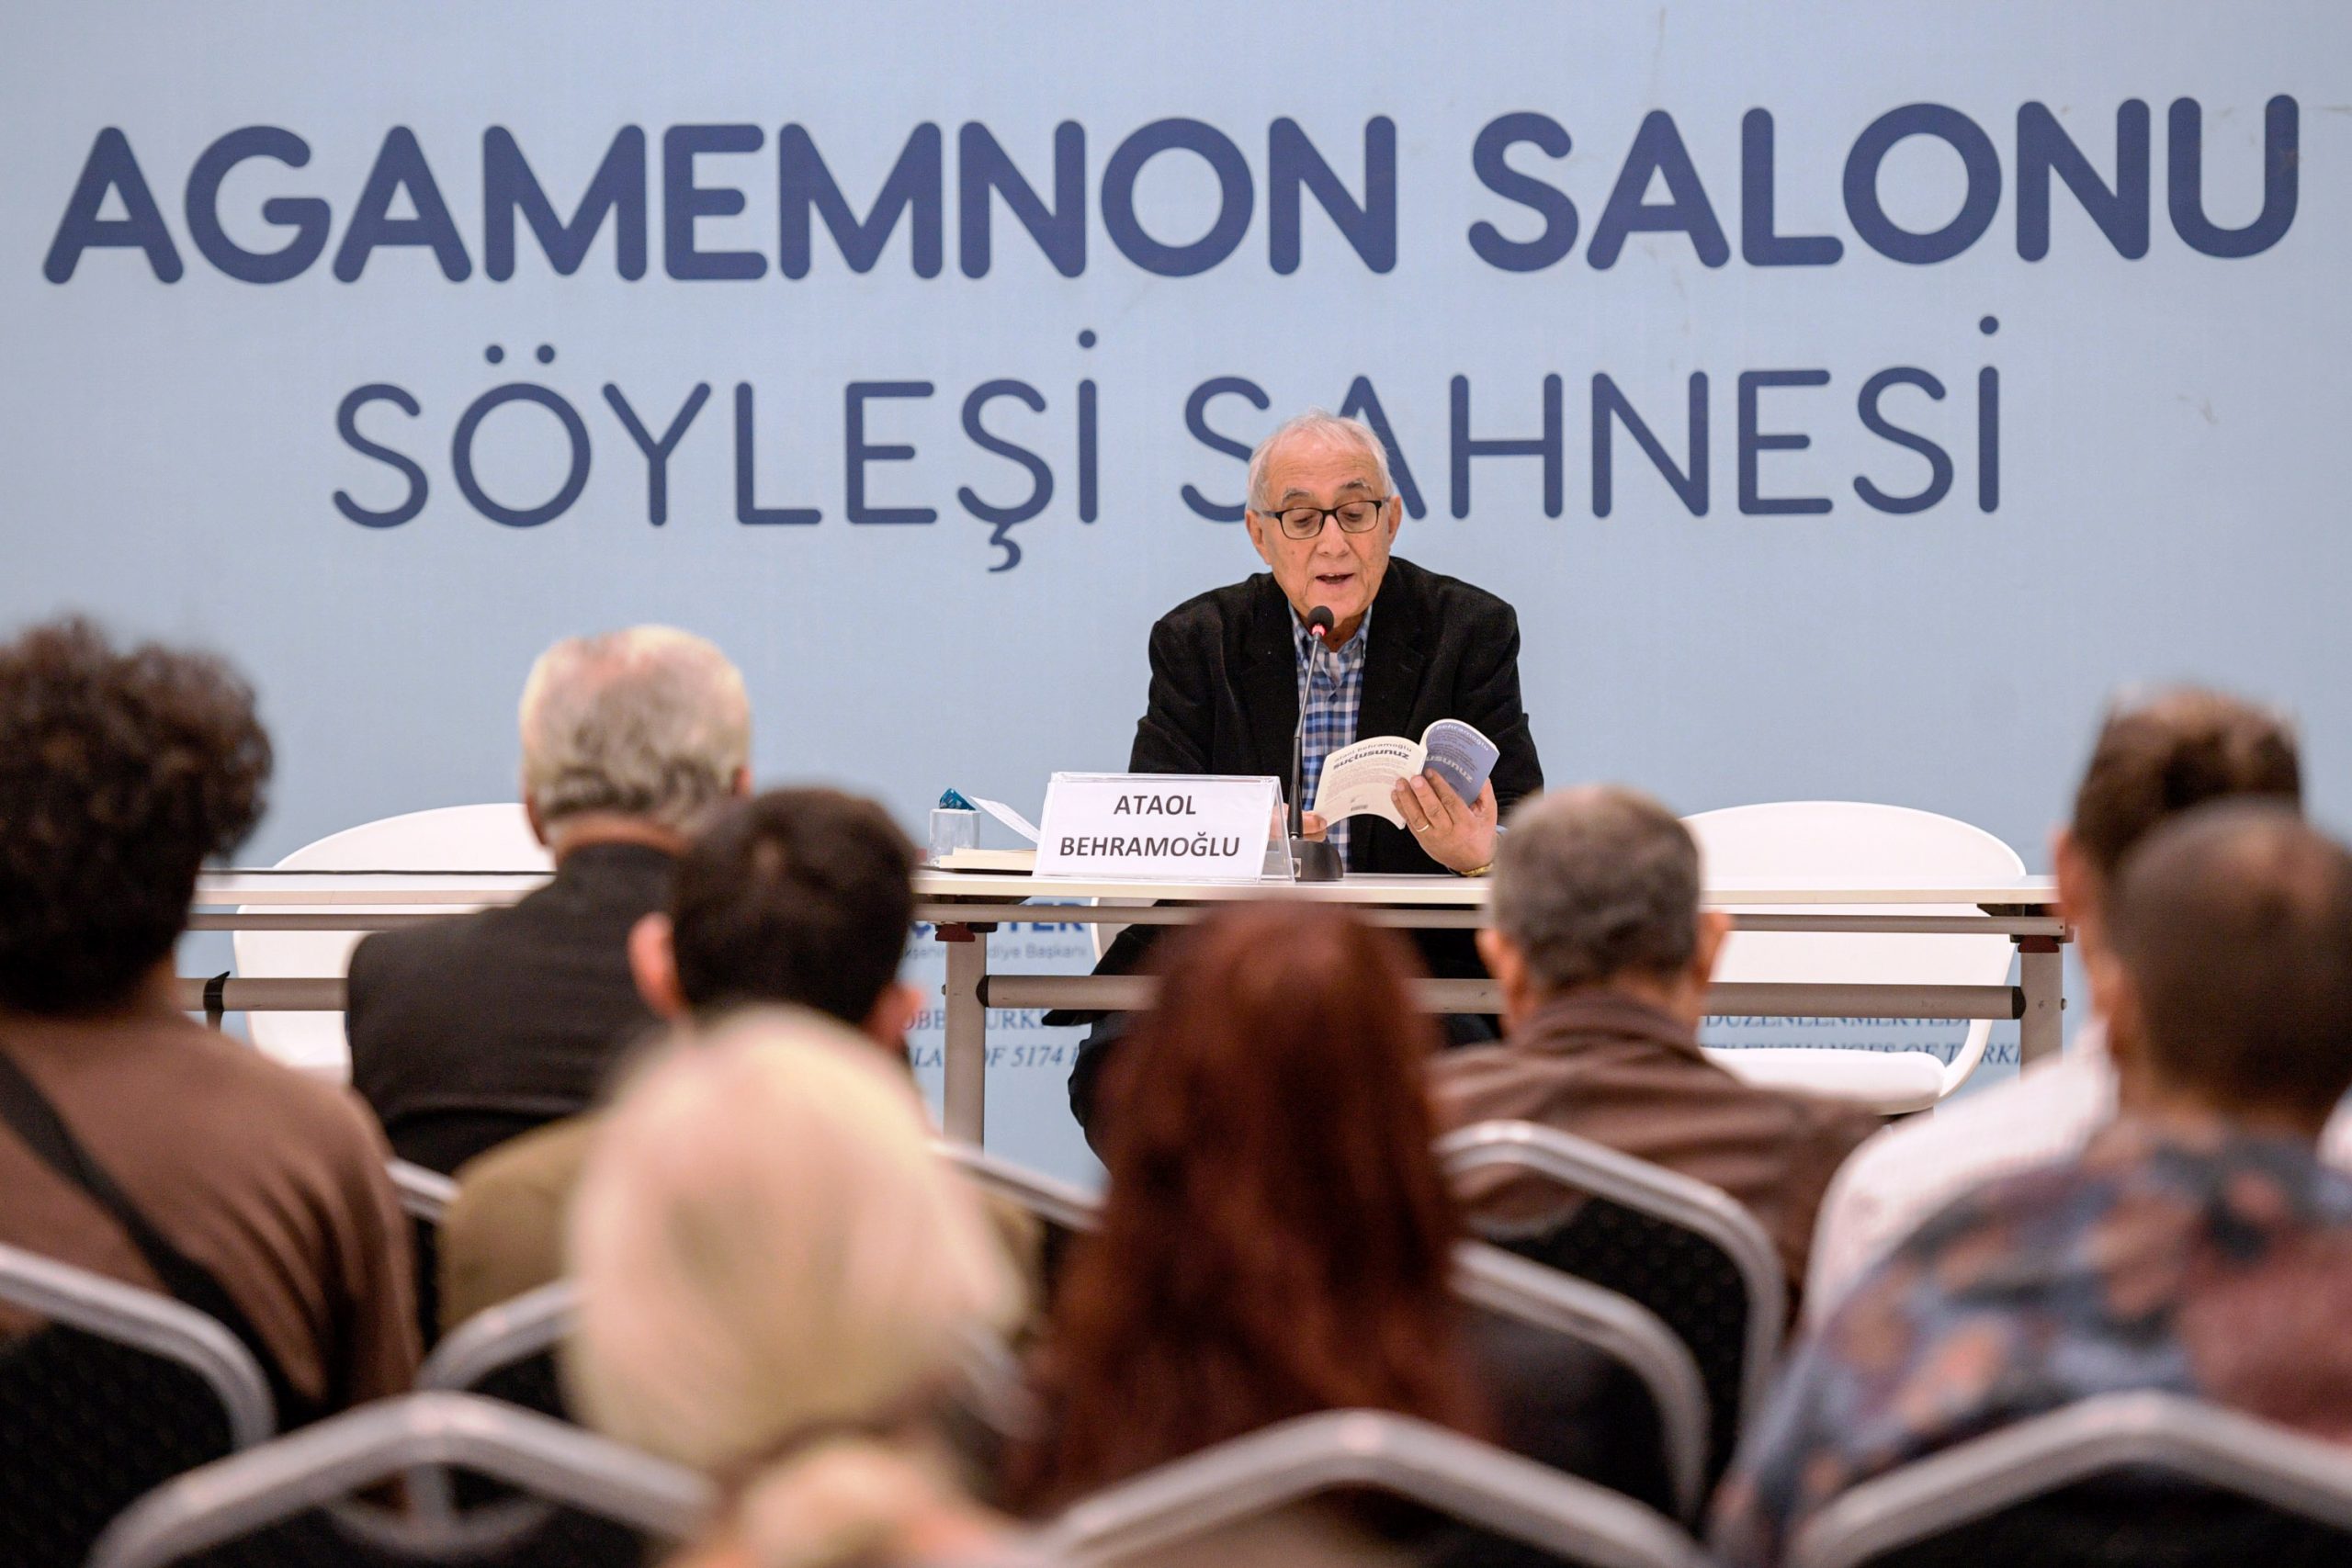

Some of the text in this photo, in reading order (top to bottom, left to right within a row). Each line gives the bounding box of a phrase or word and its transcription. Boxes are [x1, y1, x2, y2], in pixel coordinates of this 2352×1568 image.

[42, 94, 2301, 285] AGAMEMNON SALONU
[332, 329, 1099, 573] SÖYLEŞİ
[1114, 795, 1196, 816] ATAOL
[1059, 831, 1240, 857] BEHRAMOĞLU
[1010, 1045, 1063, 1067] 5174
